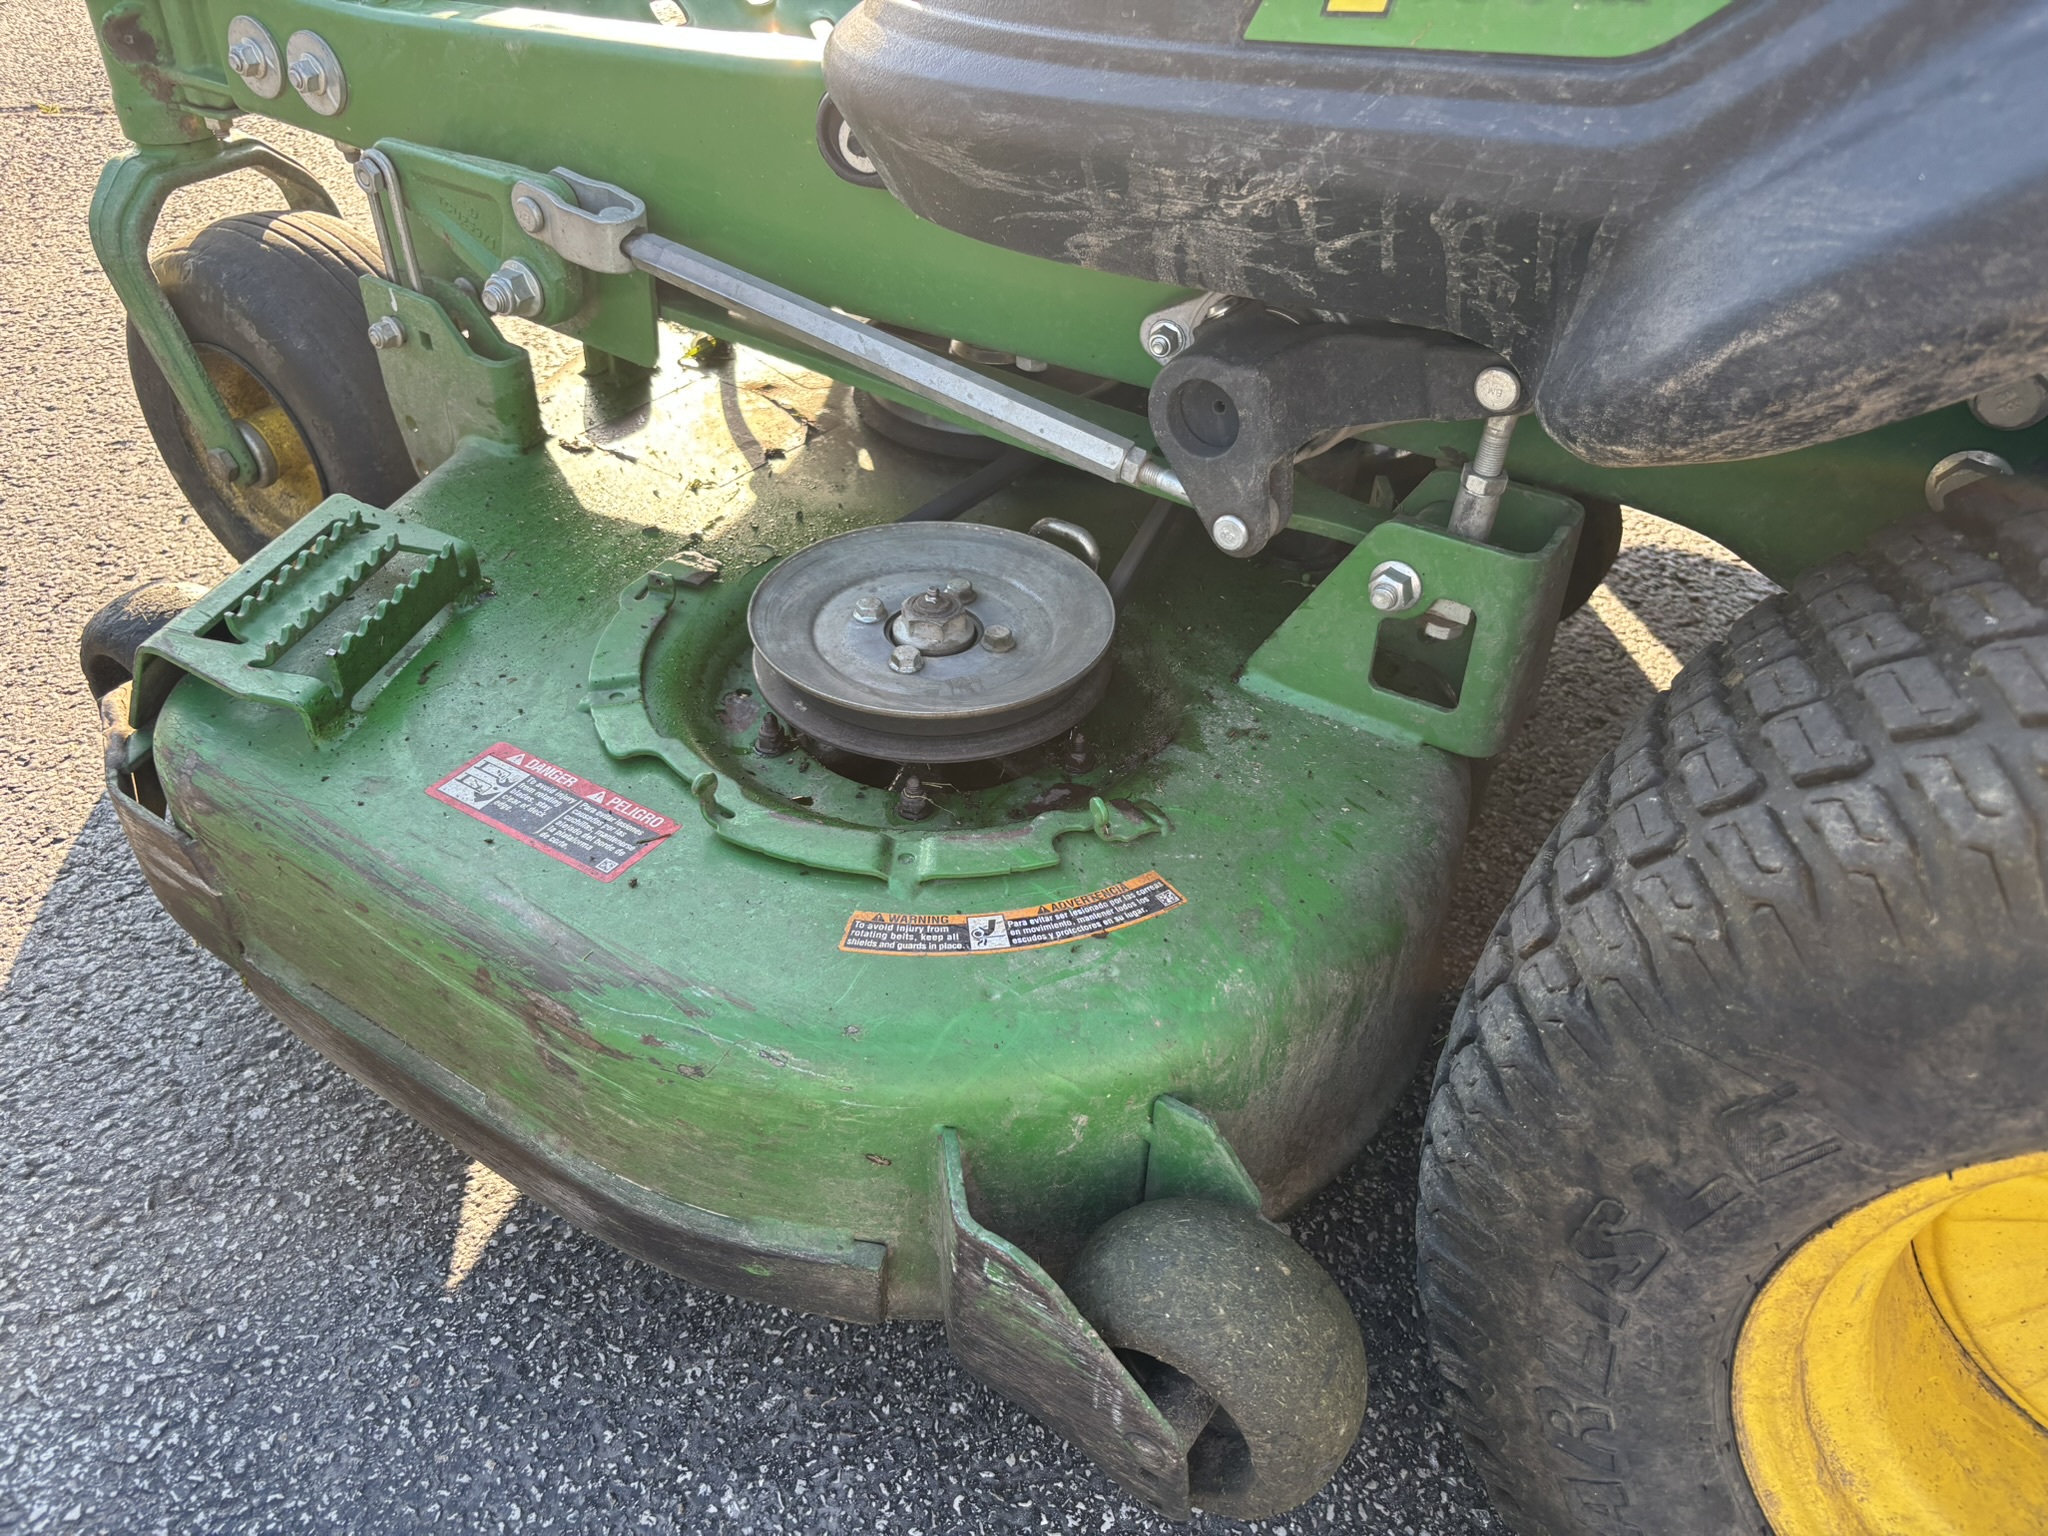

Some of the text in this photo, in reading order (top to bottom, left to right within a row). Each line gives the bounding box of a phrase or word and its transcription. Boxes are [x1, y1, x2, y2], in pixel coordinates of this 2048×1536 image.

[524, 759, 579, 788] DANGER
[510, 788, 553, 812] blades, stay
[518, 782, 563, 808] from rotating
[527, 776, 578, 805] To avoid injury
[493, 800, 513, 813] edge.
[501, 794, 547, 818] clear of deck
[579, 802, 645, 836] Para evitar lesiones
[605, 796, 665, 829] PELIGRO
[571, 809, 628, 838] causados por las
[538, 831, 568, 850] de corte.
[546, 825, 594, 851] la plataforma
[554, 820, 627, 857] alejado del borde de
[594, 829, 637, 852] mantenerse
[1007, 920, 1028, 928] Para
[1029, 915, 1054, 925] evitar
[1054, 912, 1069, 920] ser
[1068, 901, 1109, 917] lesionado
[1109, 897, 1123, 908] por
[1122, 891, 1137, 901] las
[1051, 884, 1130, 910] ADVERTENCIA
[854, 921, 950, 935] To avoid injury from
[888, 915, 949, 924] WARNING
[1009, 929, 1022, 937] en
[1076, 908, 1115, 924] mantener
[1114, 900, 1138, 913] todos
[1137, 895, 1150, 905] los
[1011, 933, 1048, 945] escudos
[1048, 932, 1055, 940] y
[1055, 920, 1103, 939] protectores
[1102, 917, 1115, 926] en
[1113, 914, 1125, 922] su
[1125, 907, 1149, 919] lugar.
[846, 938, 966, 951] shields and guards in place.
[850, 929, 960, 942] rotating belts, keep all
